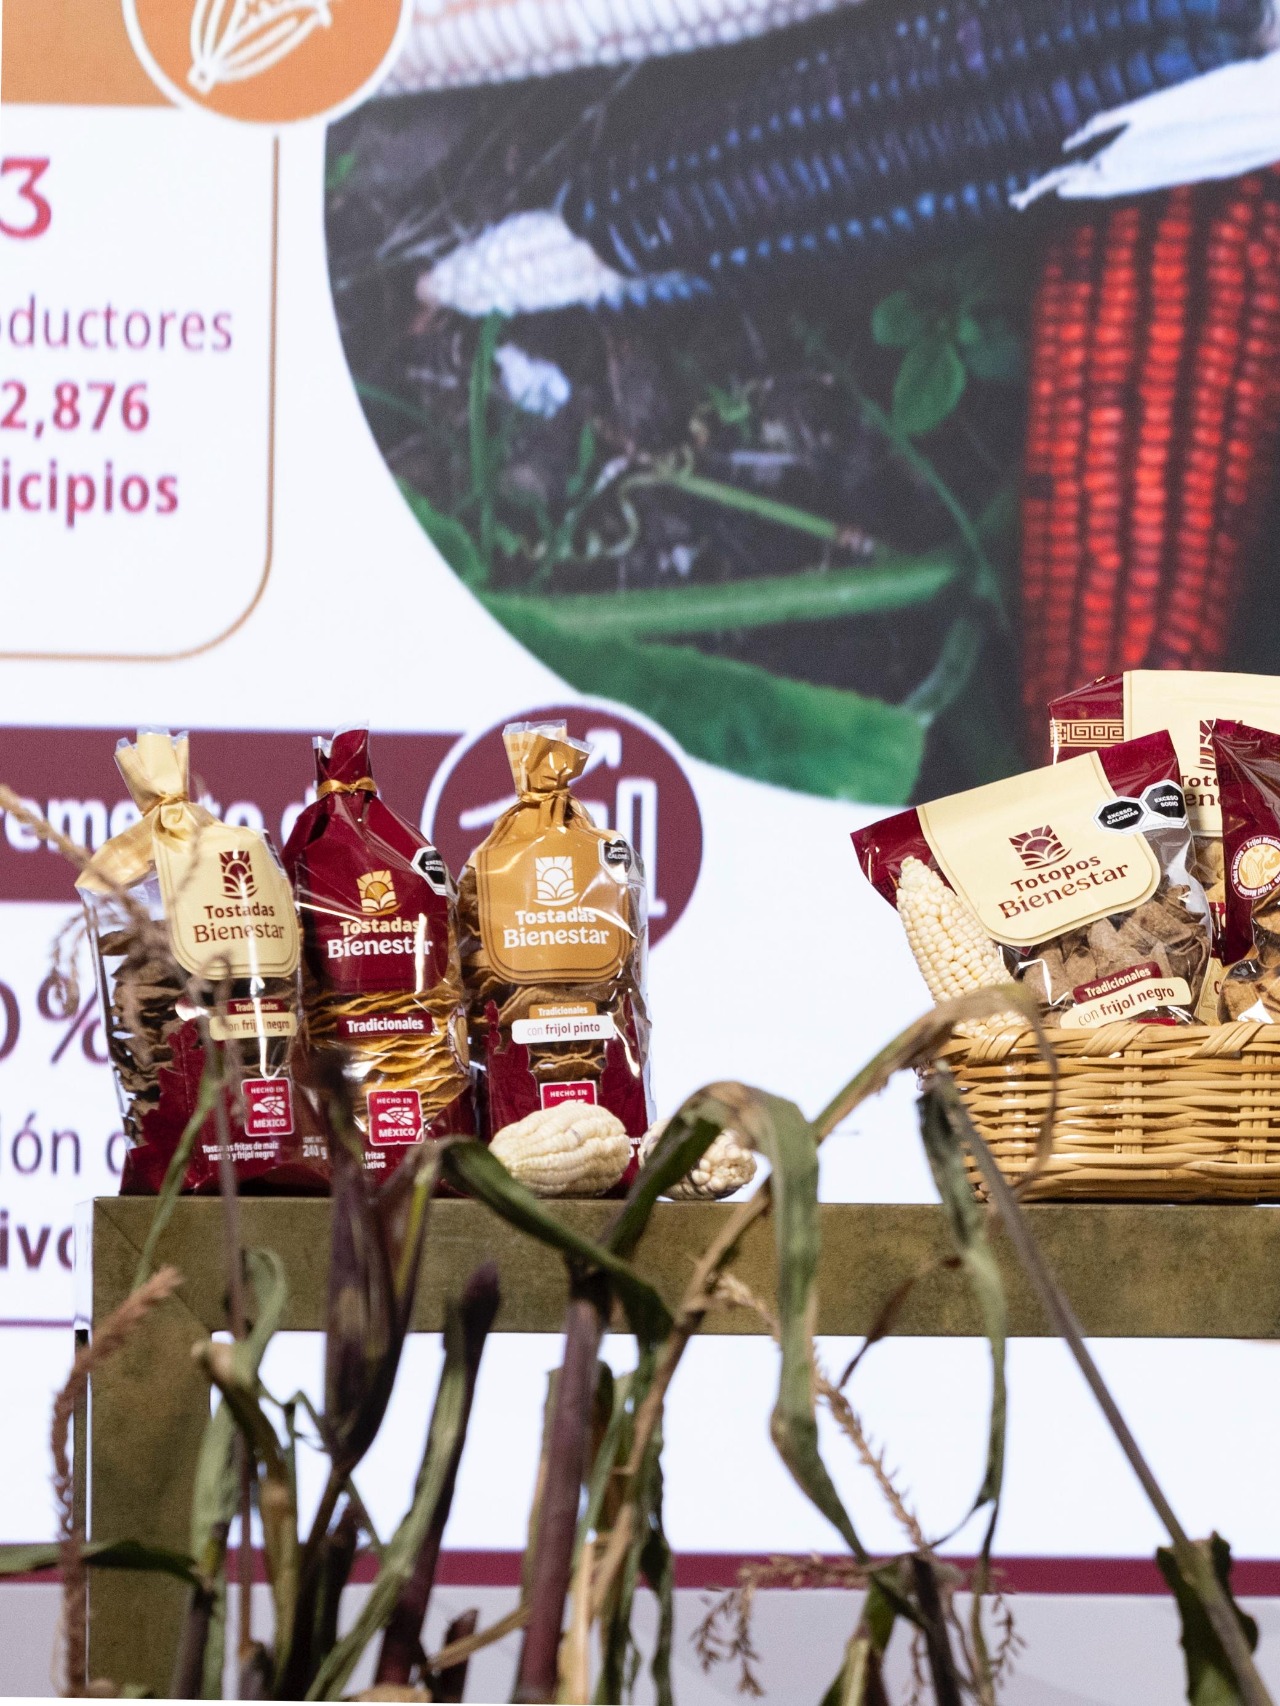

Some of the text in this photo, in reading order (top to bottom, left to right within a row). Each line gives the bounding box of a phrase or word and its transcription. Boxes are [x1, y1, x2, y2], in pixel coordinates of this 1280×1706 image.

[0, 292, 233, 351] ductores
[0, 379, 150, 440] 2,876
[1154, 795, 1178, 803] EXCESO
[1107, 807, 1132, 820] EXCESO
[1010, 856, 1101, 892] Totopos
[998, 864, 1129, 919] Bienestar
[204, 902, 275, 919] Tostadas
[515, 908, 597, 925] Tostadas
[193, 923, 284, 943] Bienestar
[340, 917, 420, 935] Tostadas
[504, 928, 609, 949] Bienestar
[327, 937, 433, 958] Bienestr
[1084, 967, 1151, 998] Tradicionales
[234, 1003, 278, 1012] Tradinales
[537, 1006, 588, 1016] Tradicionales
[1078, 987, 1175, 1026] con frijol negro
[267, 1020, 290, 1032] negro
[346, 1018, 424, 1033] Tradicionales
[527, 1022, 600, 1037] con frijol pinto
[550, 1090, 575, 1098] HECHO
[379, 1127, 415, 1138] MÉXICO
